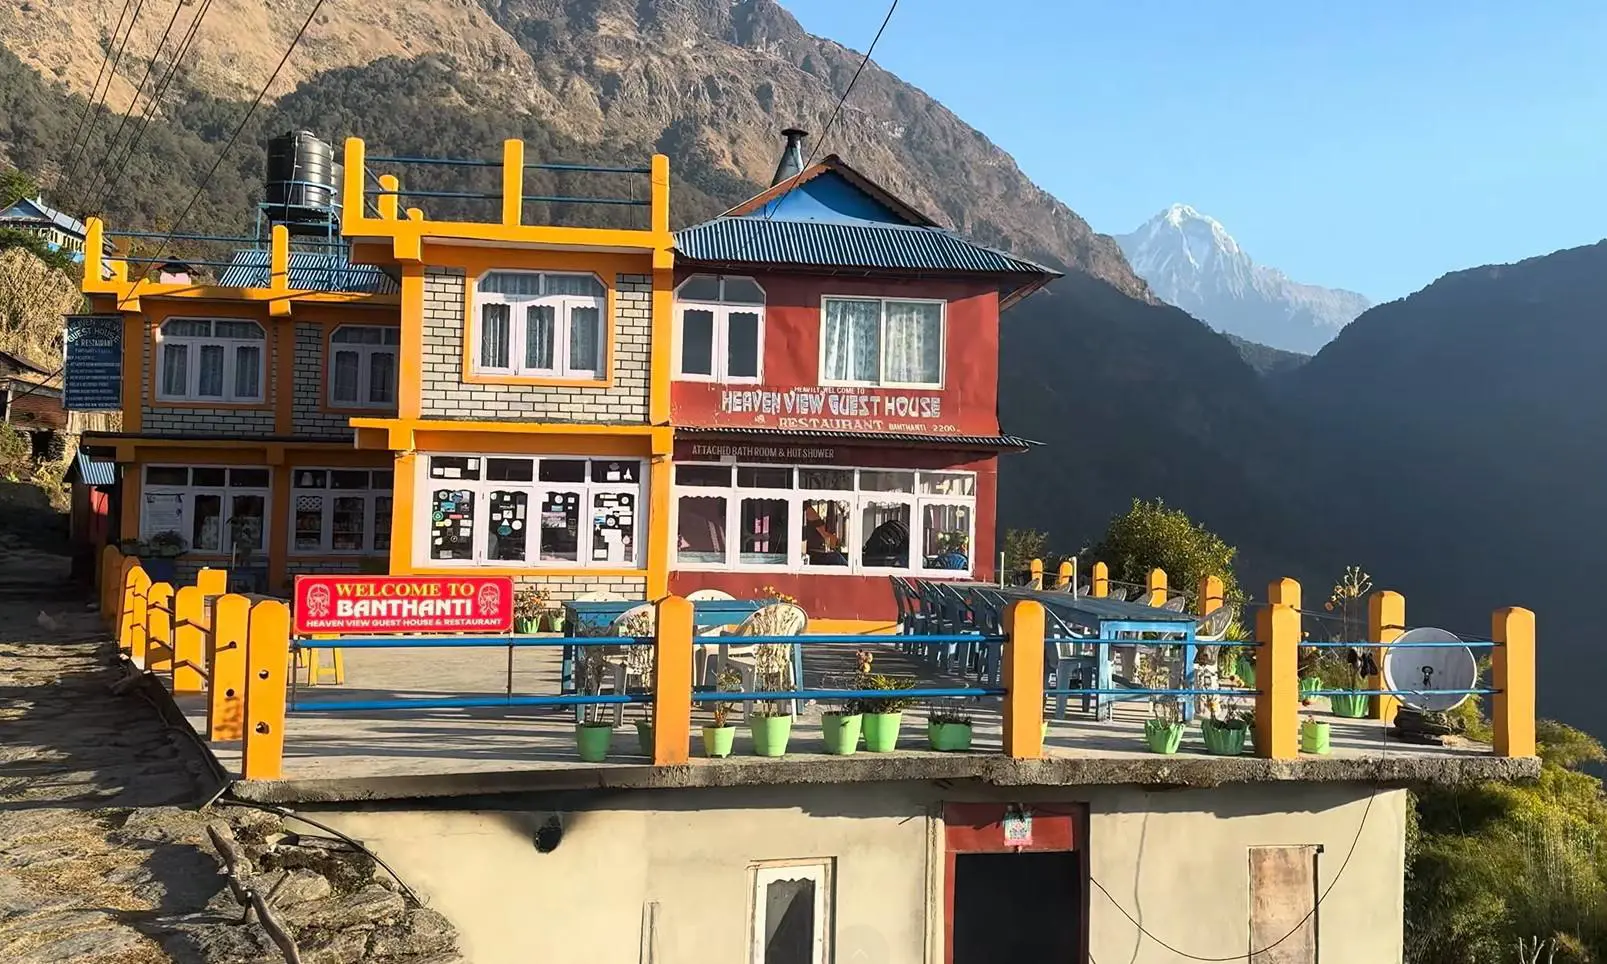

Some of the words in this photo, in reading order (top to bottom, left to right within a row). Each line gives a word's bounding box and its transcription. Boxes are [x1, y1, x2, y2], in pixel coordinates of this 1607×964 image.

[67, 327, 92, 343] GUEST
[94, 327, 121, 343] HOUSE
[721, 389, 780, 415] HEAVEN
[783, 390, 826, 415] VIEW
[828, 393, 881, 416] GUEST
[884, 395, 941, 418] HOUSE
[779, 417, 884, 431] RESTAURANT
[692, 445, 732, 456] ATTACHED
[732, 446, 755, 457] BATH
[755, 447, 777, 458] ROOM
[779, 448, 786, 457] &
[336, 583, 442, 597] WELCOME
[448, 583, 476, 597] TO
[336, 599, 473, 617] BANTHANTI
[306, 620, 344, 628] HEAVEN
[346, 619, 370, 627] VIEW
[372, 619, 401, 627] GUEST
[444, 618, 502, 626] RESTAURANT
